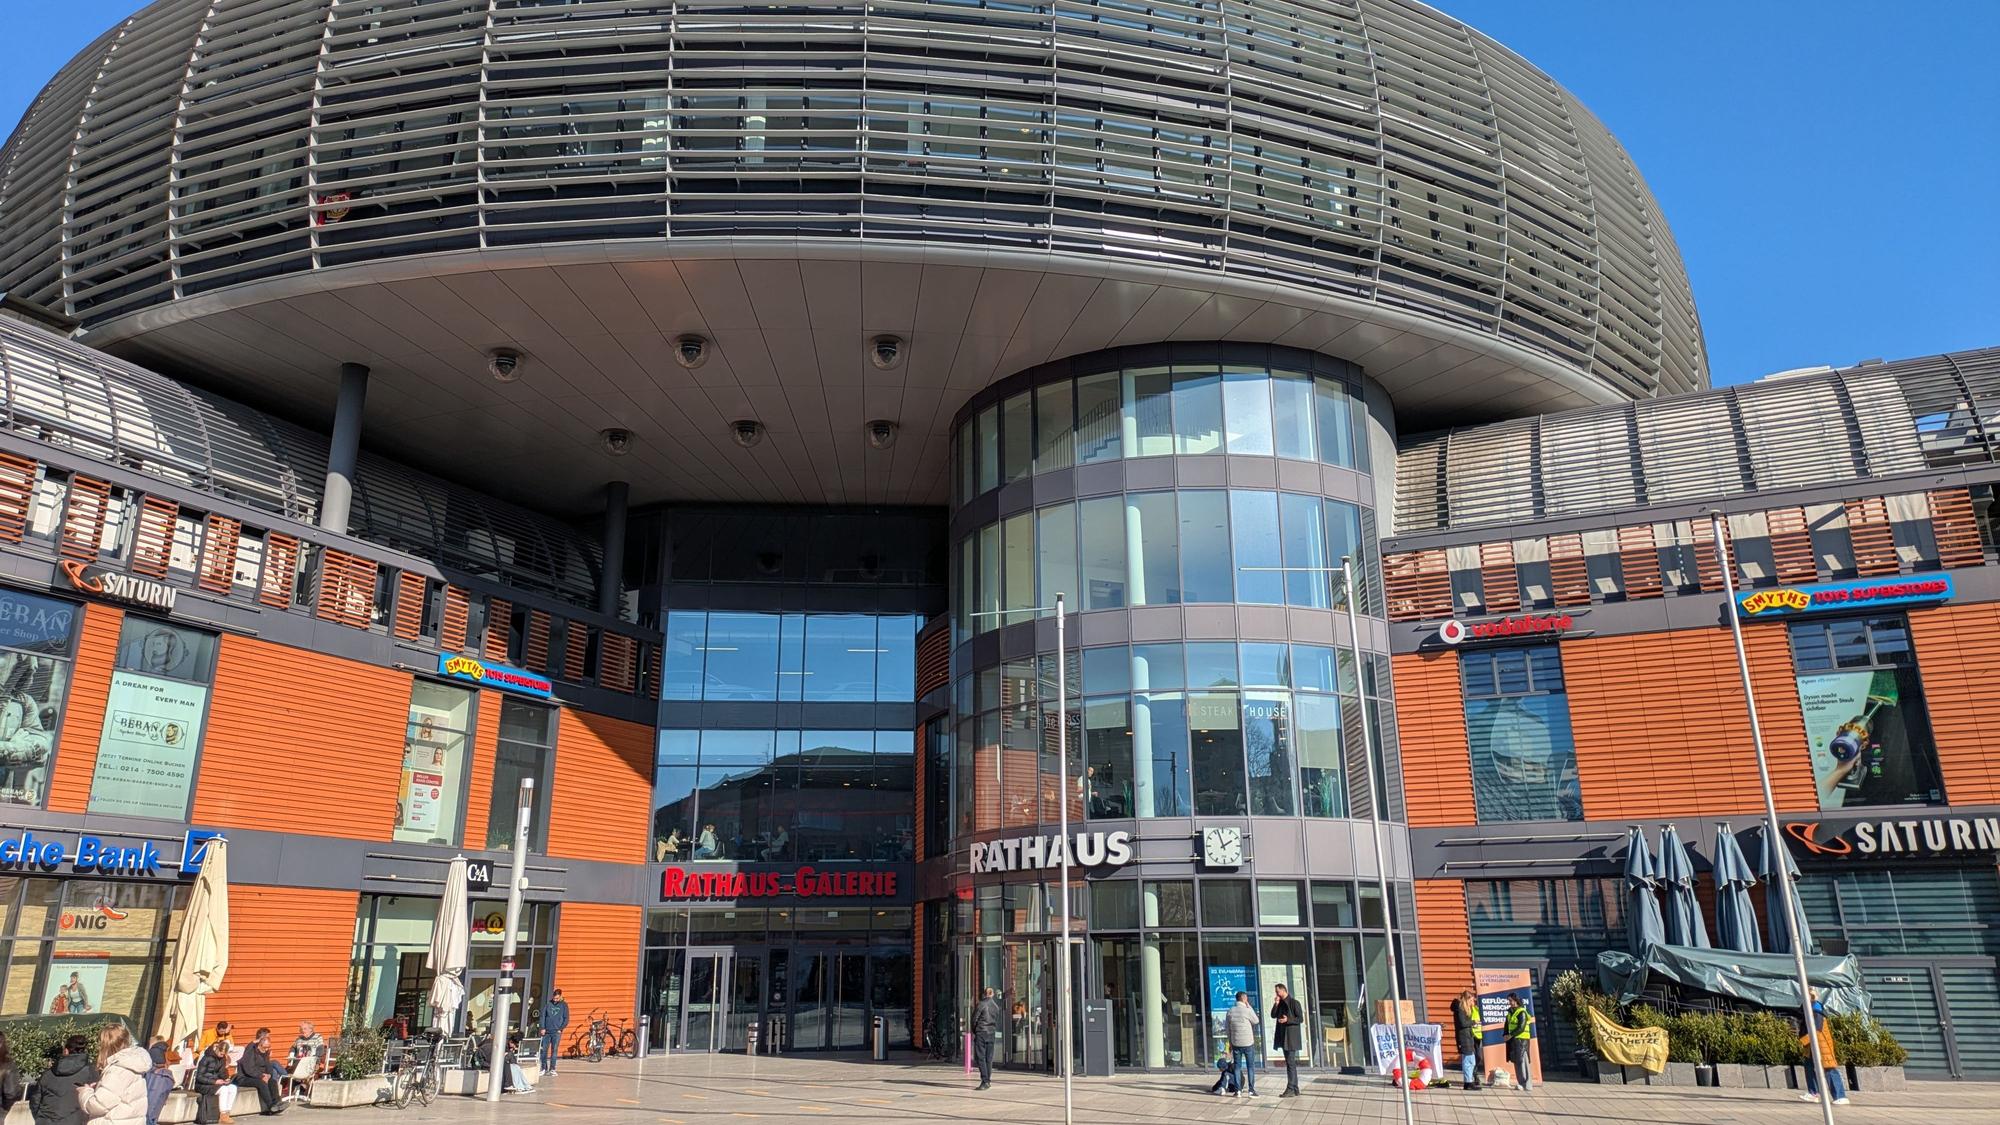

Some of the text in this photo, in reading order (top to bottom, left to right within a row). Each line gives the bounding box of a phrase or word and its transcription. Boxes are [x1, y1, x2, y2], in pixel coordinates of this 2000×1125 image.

[103, 572, 177, 608] SATURN
[1743, 580, 1948, 611] SMYTHS TOYS SUPERSTORES
[13, 628, 39, 641] Shop
[1471, 614, 1573, 638] vodafone
[448, 659, 484, 678] SMYTHS
[122, 681, 148, 690] DREAM
[155, 696, 178, 704] EVERY
[1200, 706, 1286, 717] STEAK HOUSE
[120, 718, 160, 732] BEBAN
[146, 768, 165, 776] 7500
[1855, 818, 2000, 853] SATURN
[74, 836, 161, 870] Bank
[970, 831, 1133, 874] RATHAUS
[467, 864, 489, 882] C&A
